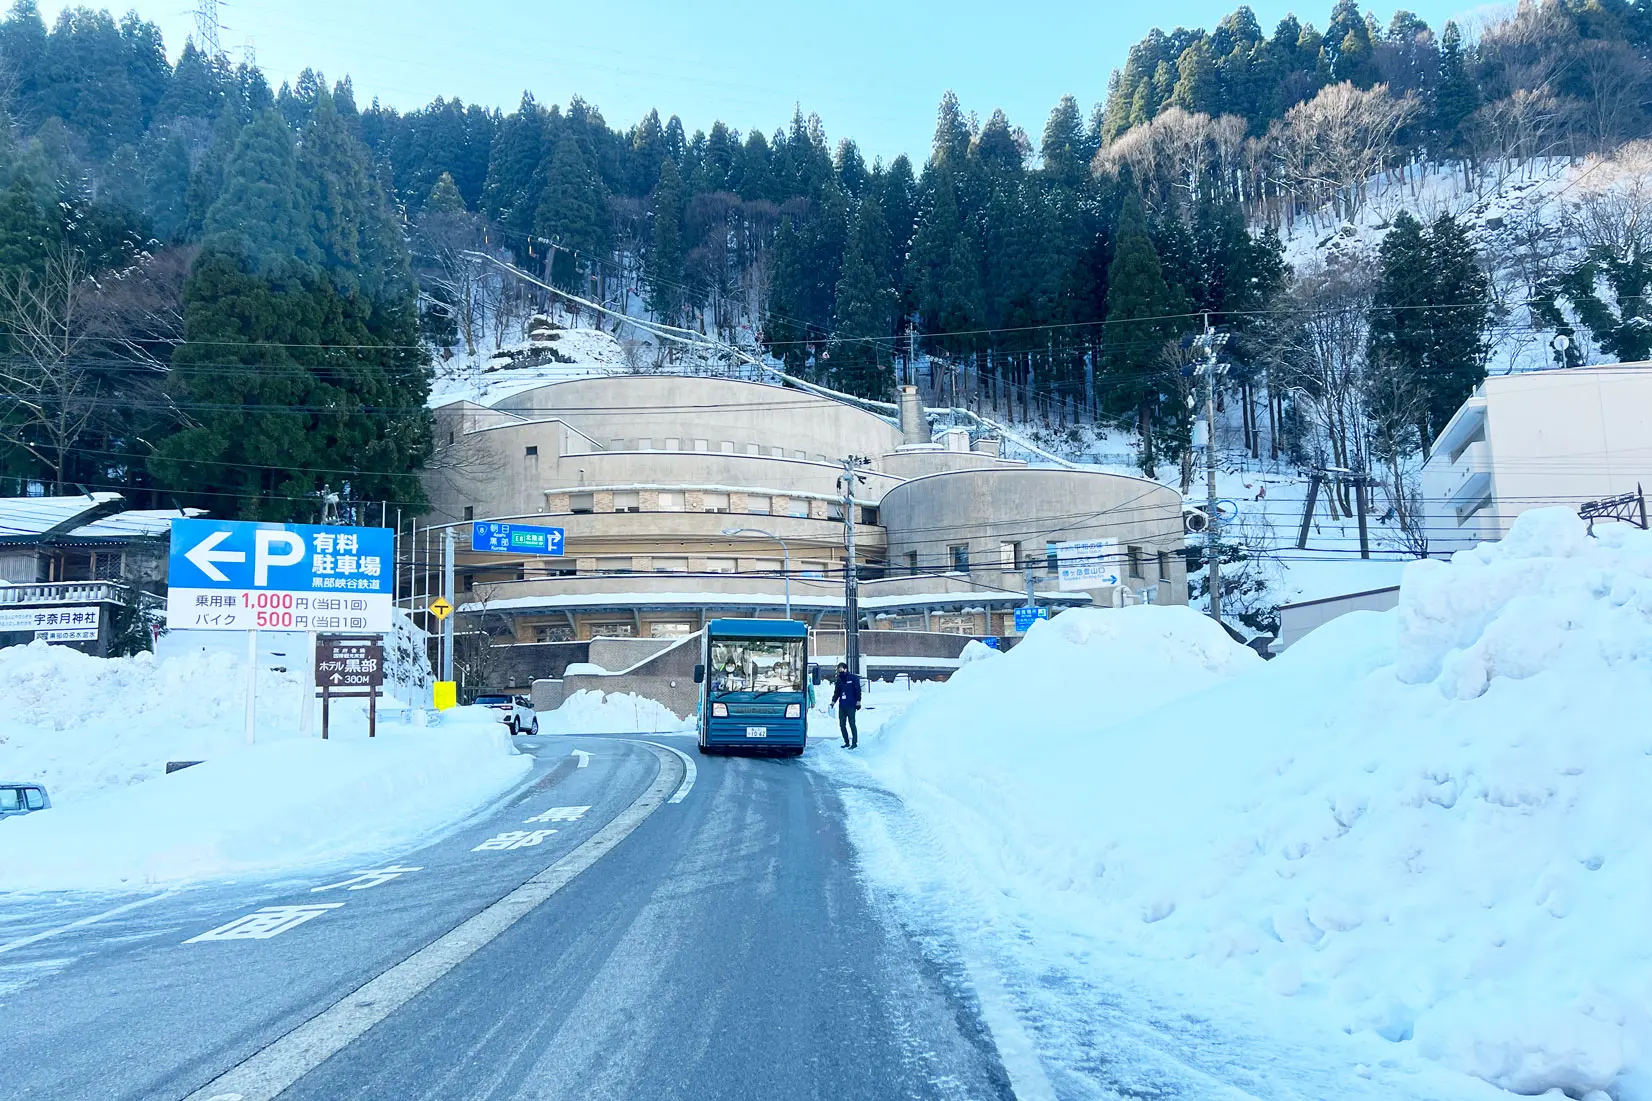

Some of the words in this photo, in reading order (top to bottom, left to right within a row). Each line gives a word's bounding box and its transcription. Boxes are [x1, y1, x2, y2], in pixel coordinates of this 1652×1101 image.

[490, 524, 509, 533] 朝日
[312, 532, 358, 553] 有料
[489, 537, 509, 547] 黒部
[254, 529, 305, 586] P
[312, 554, 381, 576] 駐車場
[311, 577, 380, 590] 黒部峡谷鉄道
[195, 594, 237, 608] 乗用車
[34, 611, 96, 626] 宇奈月神社
[195, 613, 236, 626] バイク
[319, 658, 377, 673] ホテル黒部
